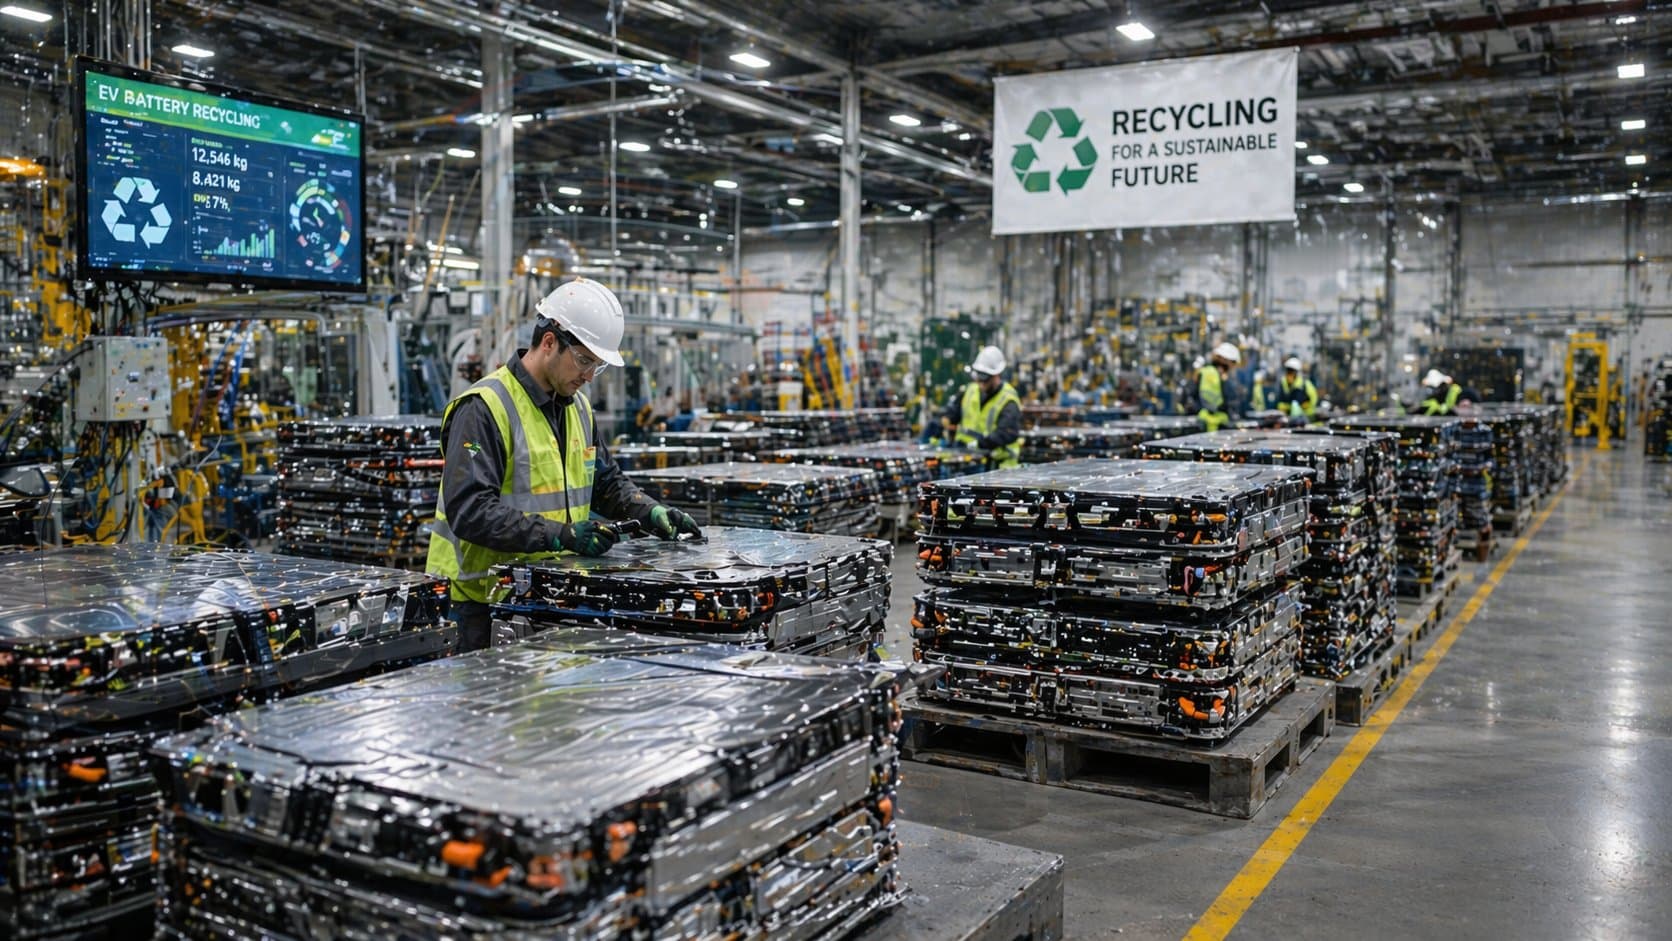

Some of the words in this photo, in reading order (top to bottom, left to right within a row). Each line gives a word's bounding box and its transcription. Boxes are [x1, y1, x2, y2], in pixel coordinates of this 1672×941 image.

[99, 84, 120, 102] EV
[124, 90, 190, 116] BATTERY
[192, 103, 261, 129] RECYCLING
[1112, 98, 1277, 135] RECYCLING
[191, 146, 231, 166] 12,546
[233, 153, 248, 171] kg
[1112, 143, 1143, 160] FOR
[1148, 142, 1159, 158] A
[1164, 134, 1277, 156] SUSTAINABLE
[1112, 163, 1198, 187] FUTURE
